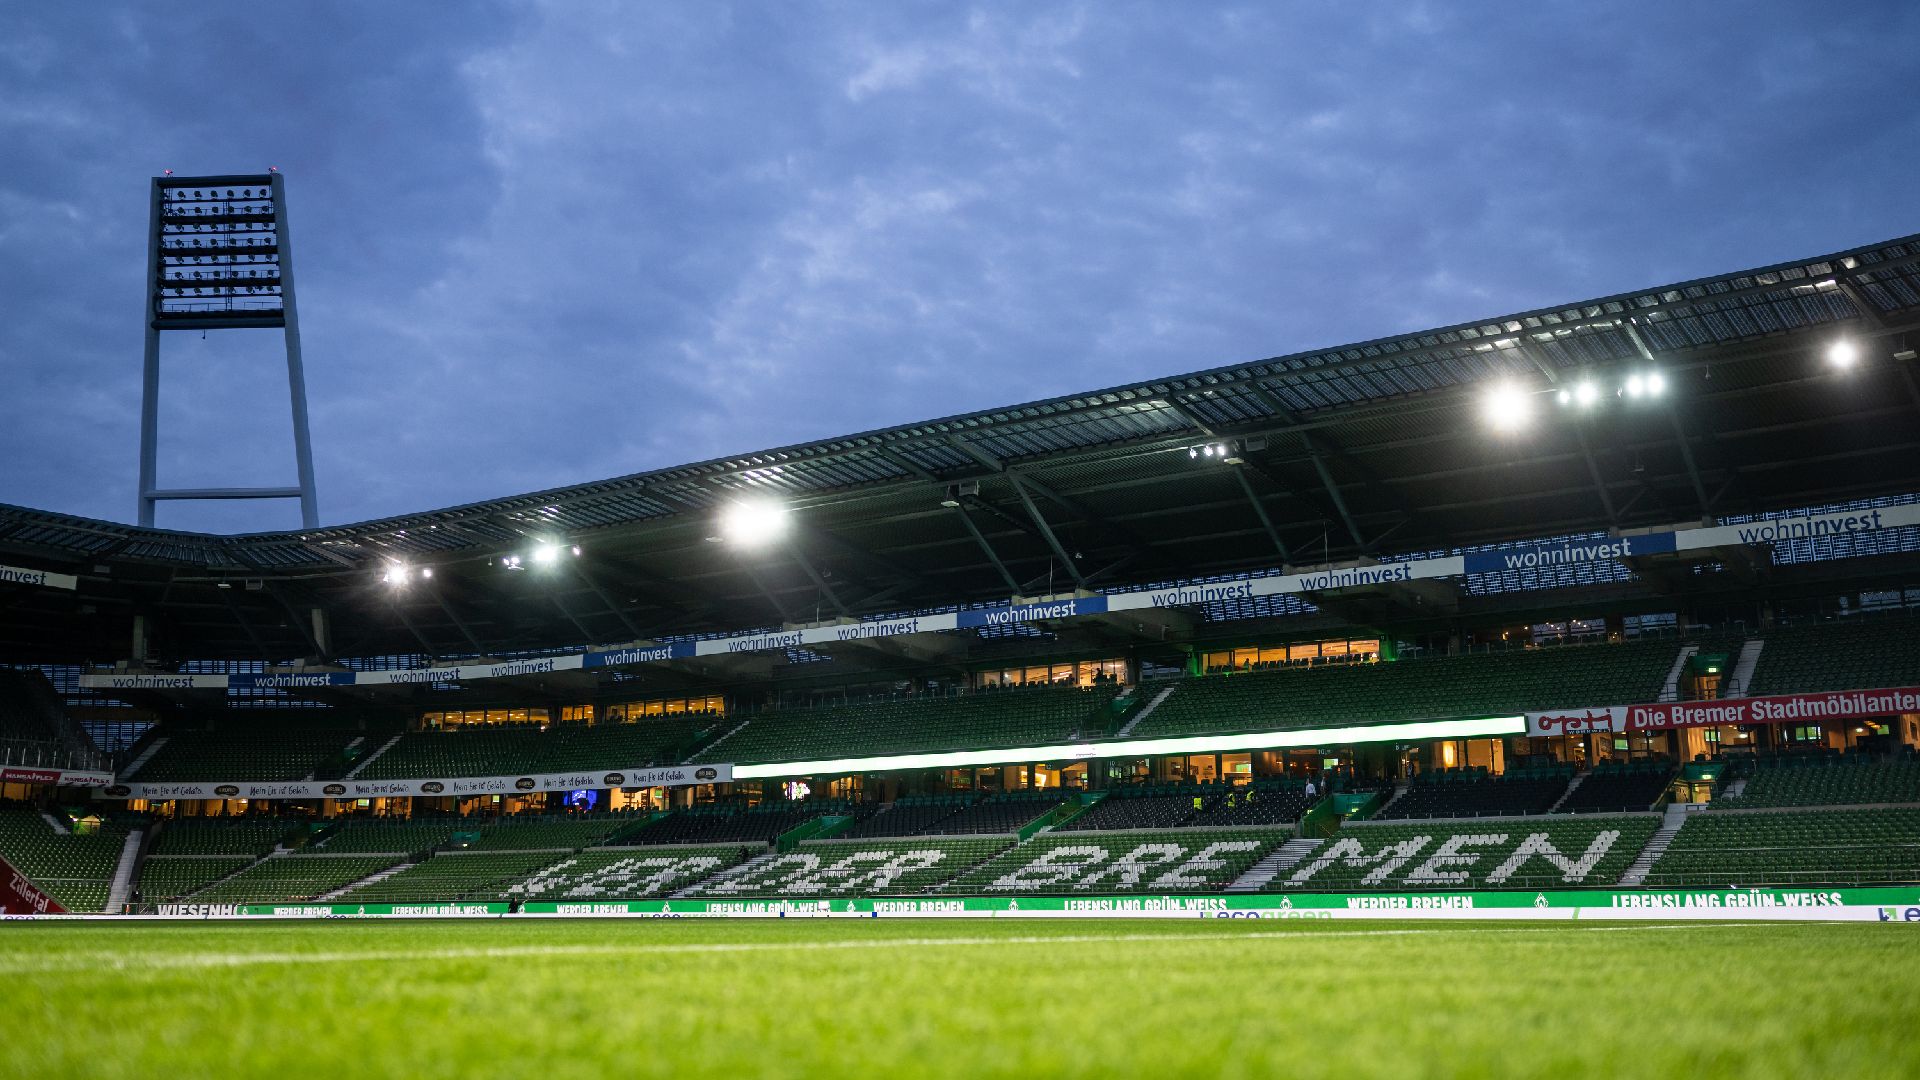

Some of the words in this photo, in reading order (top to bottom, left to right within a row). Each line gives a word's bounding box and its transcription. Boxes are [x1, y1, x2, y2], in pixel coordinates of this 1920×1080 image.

[1738, 509, 1882, 543] wohninvest
[1505, 538, 1632, 568] wohninvest
[1300, 563, 1412, 591] wohninvest
[1152, 581, 1252, 606] wohninvest
[986, 600, 1076, 625] wohninvest
[837, 618, 919, 640] wohninvest
[728, 632, 804, 653] wohninvest
[605, 645, 673, 666] wohninvest
[390, 668, 460, 683] wohninvest
[491, 660, 554, 677] wohninvest
[113, 675, 194, 688] wohninvest
[255, 674, 330, 687] wohninvest
[1634, 708, 1666, 728] Die
[1671, 706, 1746, 724] Bremer
[10, 872, 49, 912] Zillertal
[1347, 897, 1408, 909] WERDER
[1412, 896, 1473, 908] BREMEN
[158, 904, 238, 916] WIESENH
[874, 902, 917, 912] WERDER
[920, 901, 964, 912] BREMEN
